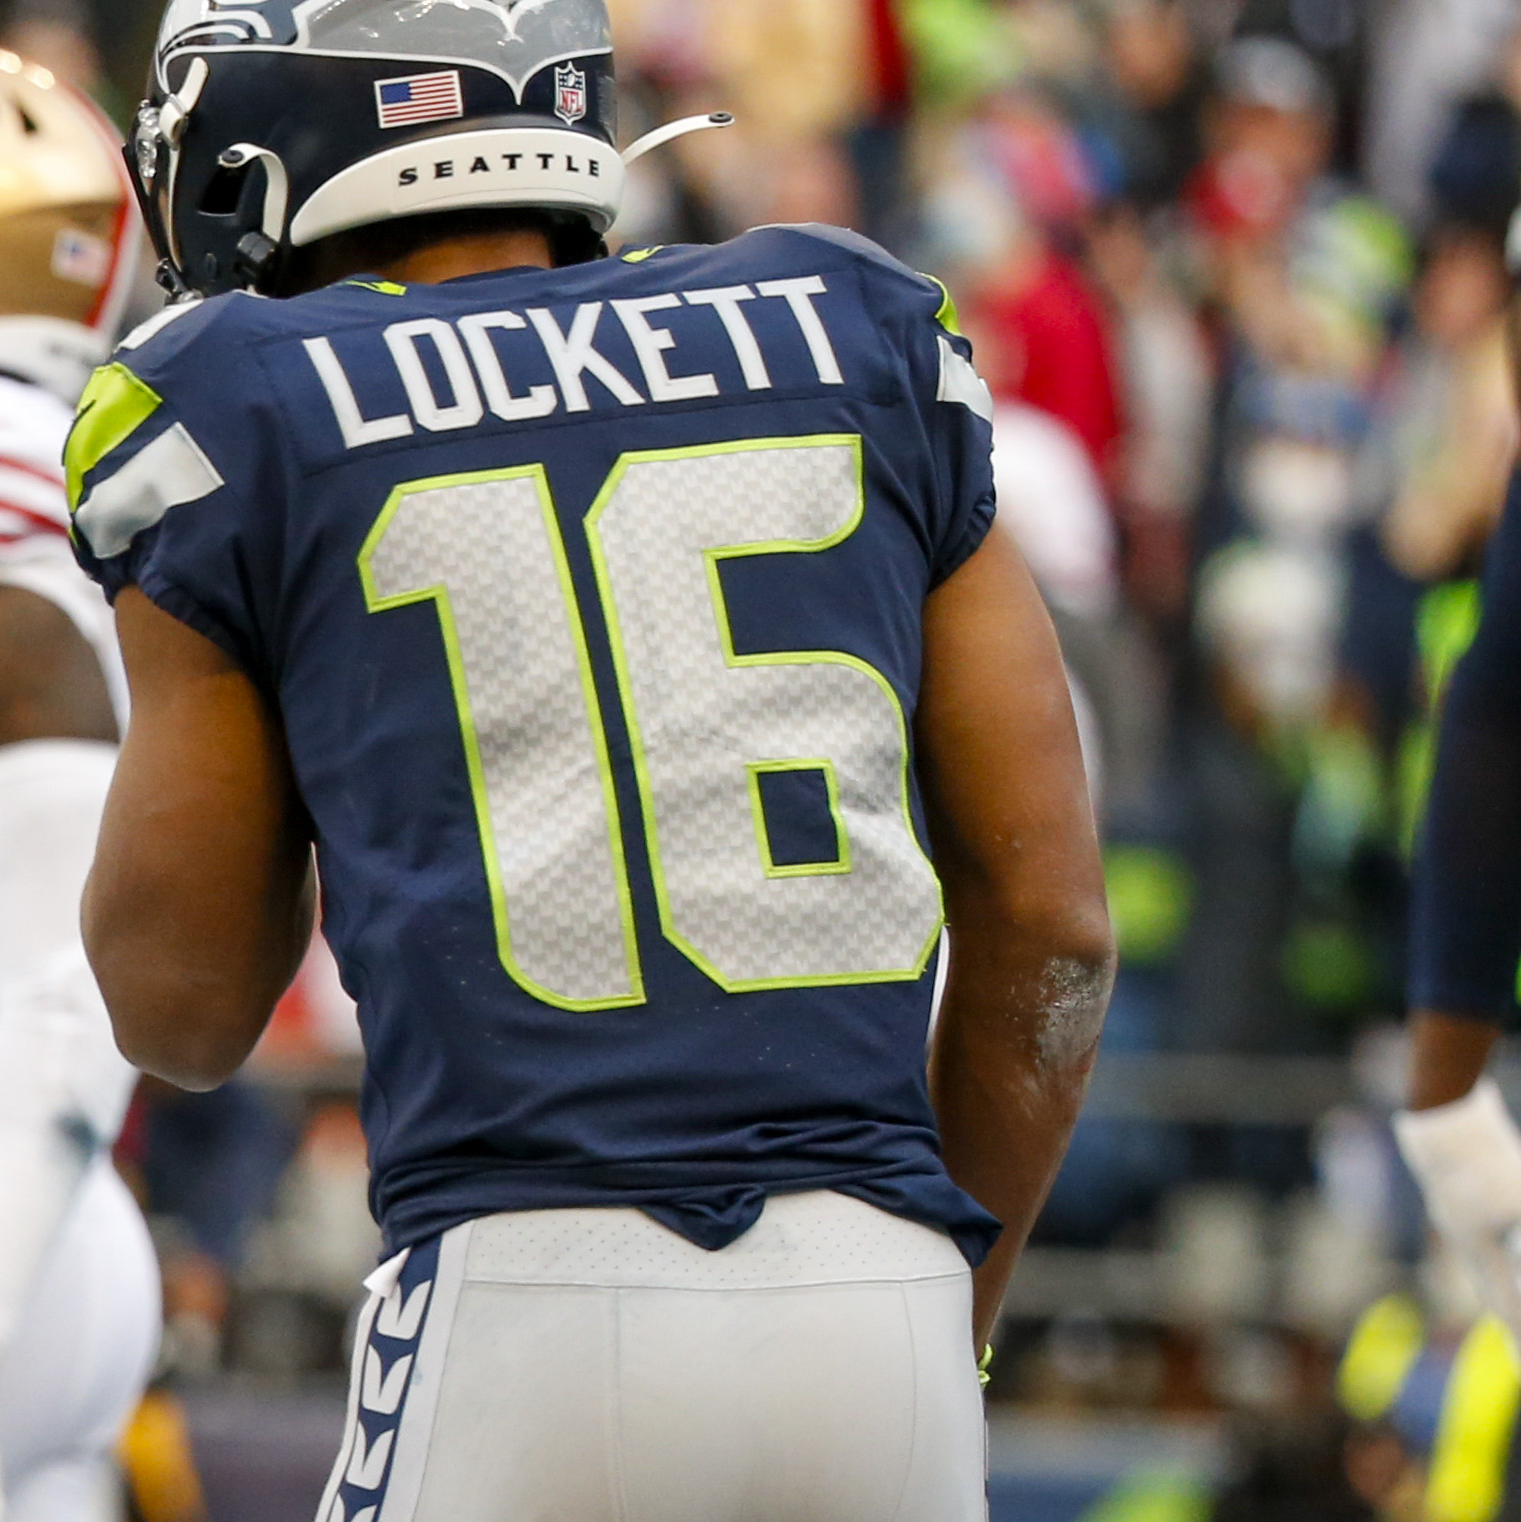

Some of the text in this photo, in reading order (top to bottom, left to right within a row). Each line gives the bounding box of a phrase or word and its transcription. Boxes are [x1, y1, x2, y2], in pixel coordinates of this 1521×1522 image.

[398, 153, 600, 187] SEATTLE
[302, 275, 845, 450] LOCKETT
[357, 433, 945, 1012] 16
